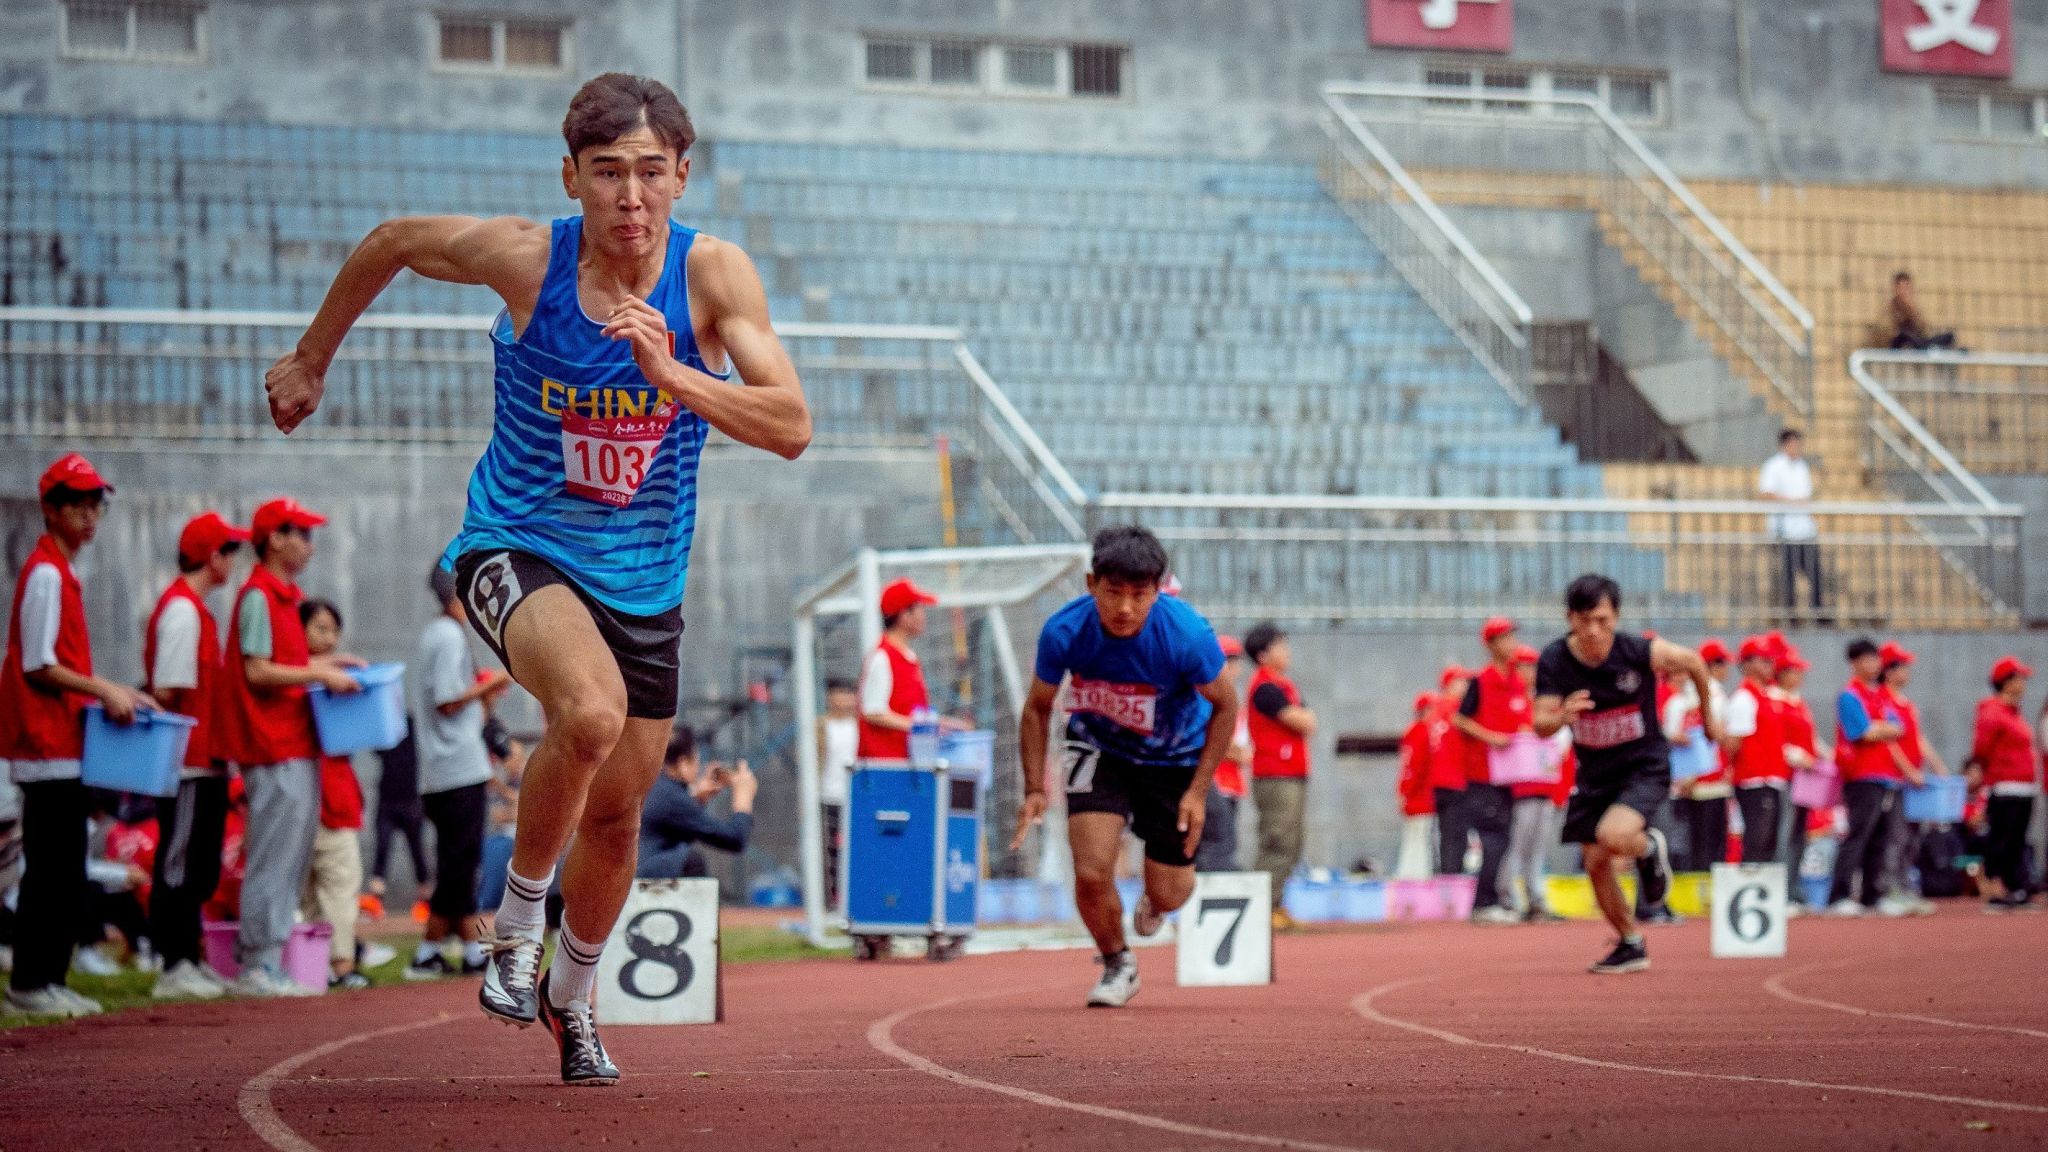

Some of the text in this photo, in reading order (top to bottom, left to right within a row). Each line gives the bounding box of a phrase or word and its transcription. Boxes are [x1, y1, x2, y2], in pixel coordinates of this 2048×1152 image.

[542, 379, 674, 419] CHINA
[575, 440, 661, 490] 103
[474, 562, 510, 631] 8
[1066, 745, 1095, 786] 7
[1197, 897, 1250, 967] 7
[1728, 883, 1770, 942] 6
[618, 909, 695, 1000] 8
